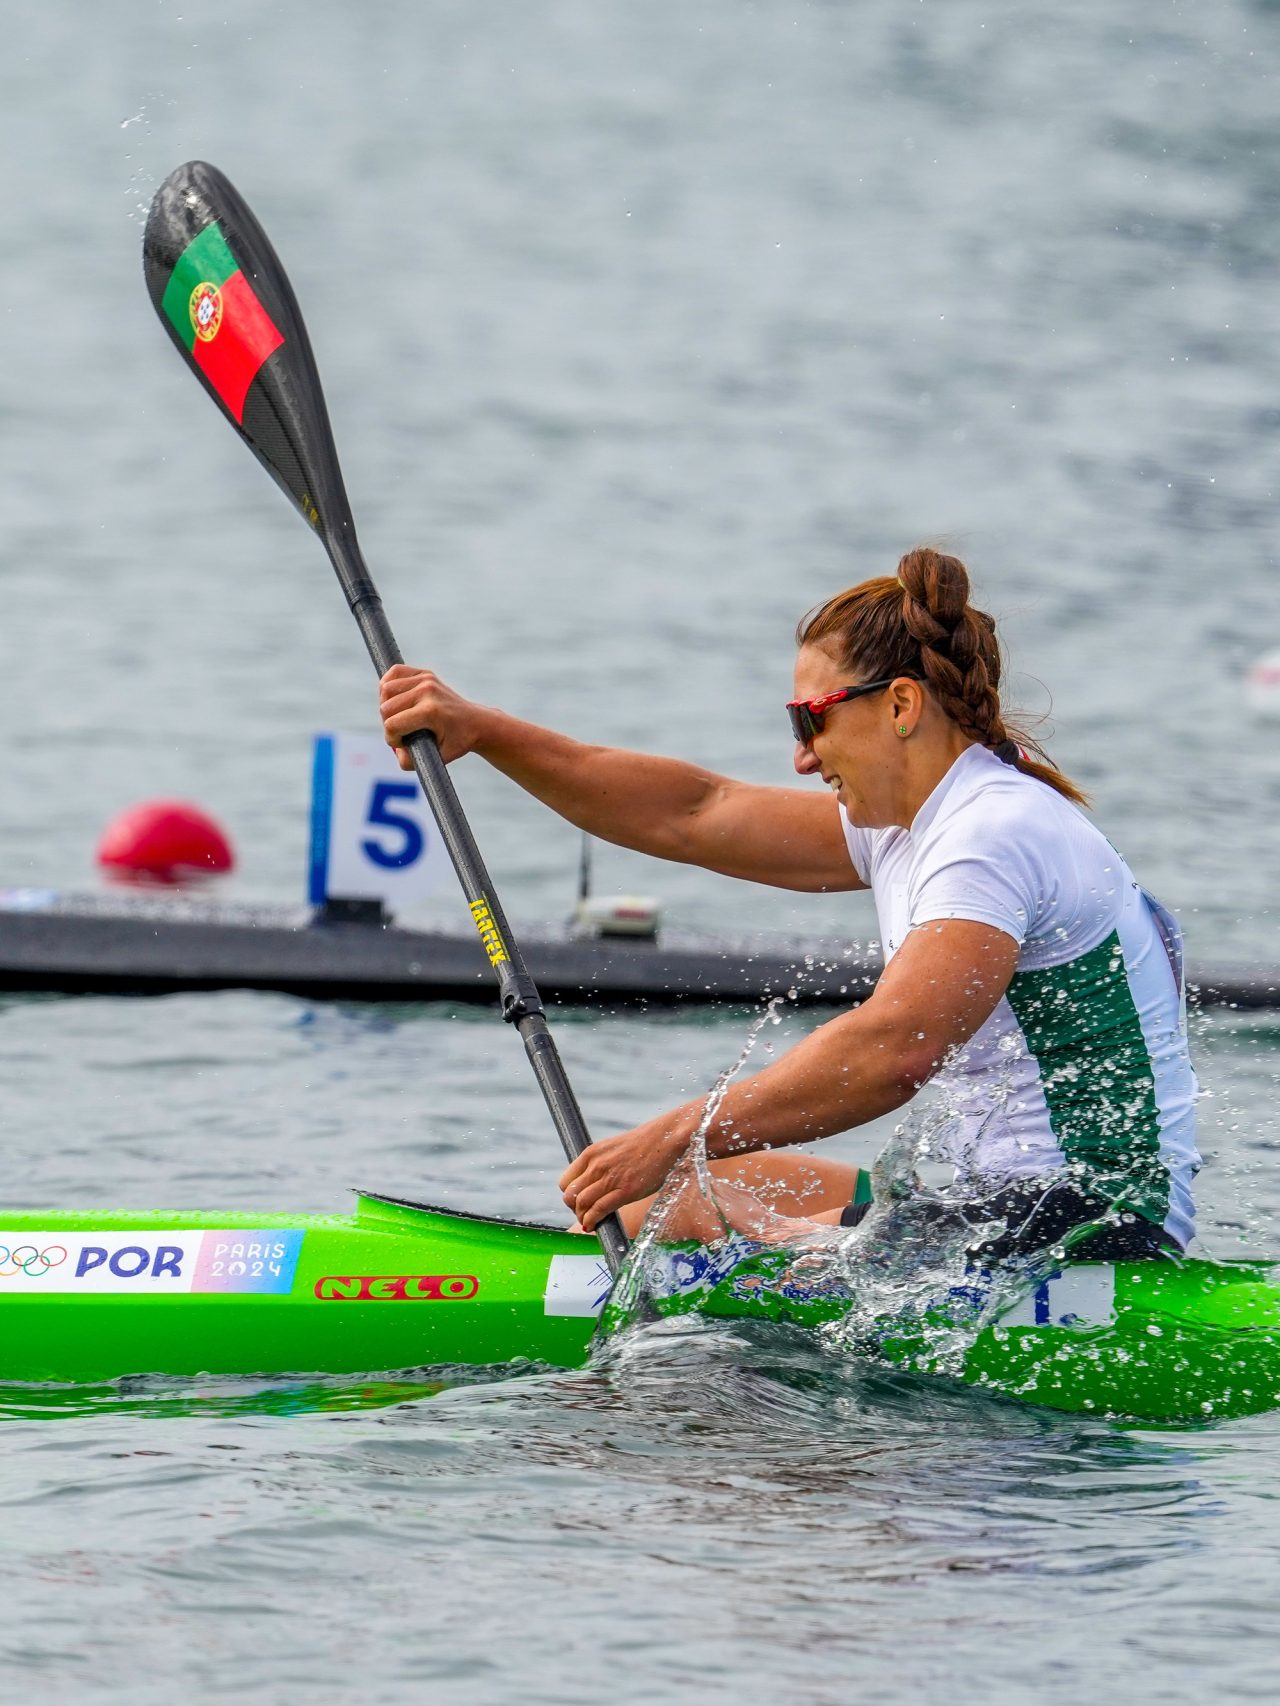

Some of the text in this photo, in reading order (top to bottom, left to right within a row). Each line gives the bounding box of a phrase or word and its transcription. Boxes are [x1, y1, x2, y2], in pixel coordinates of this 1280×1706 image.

[361, 780, 424, 869] 5
[75, 1246, 184, 1278] POR
[211, 1261, 281, 1277] 2024
[320, 1277, 475, 1298] NELO
